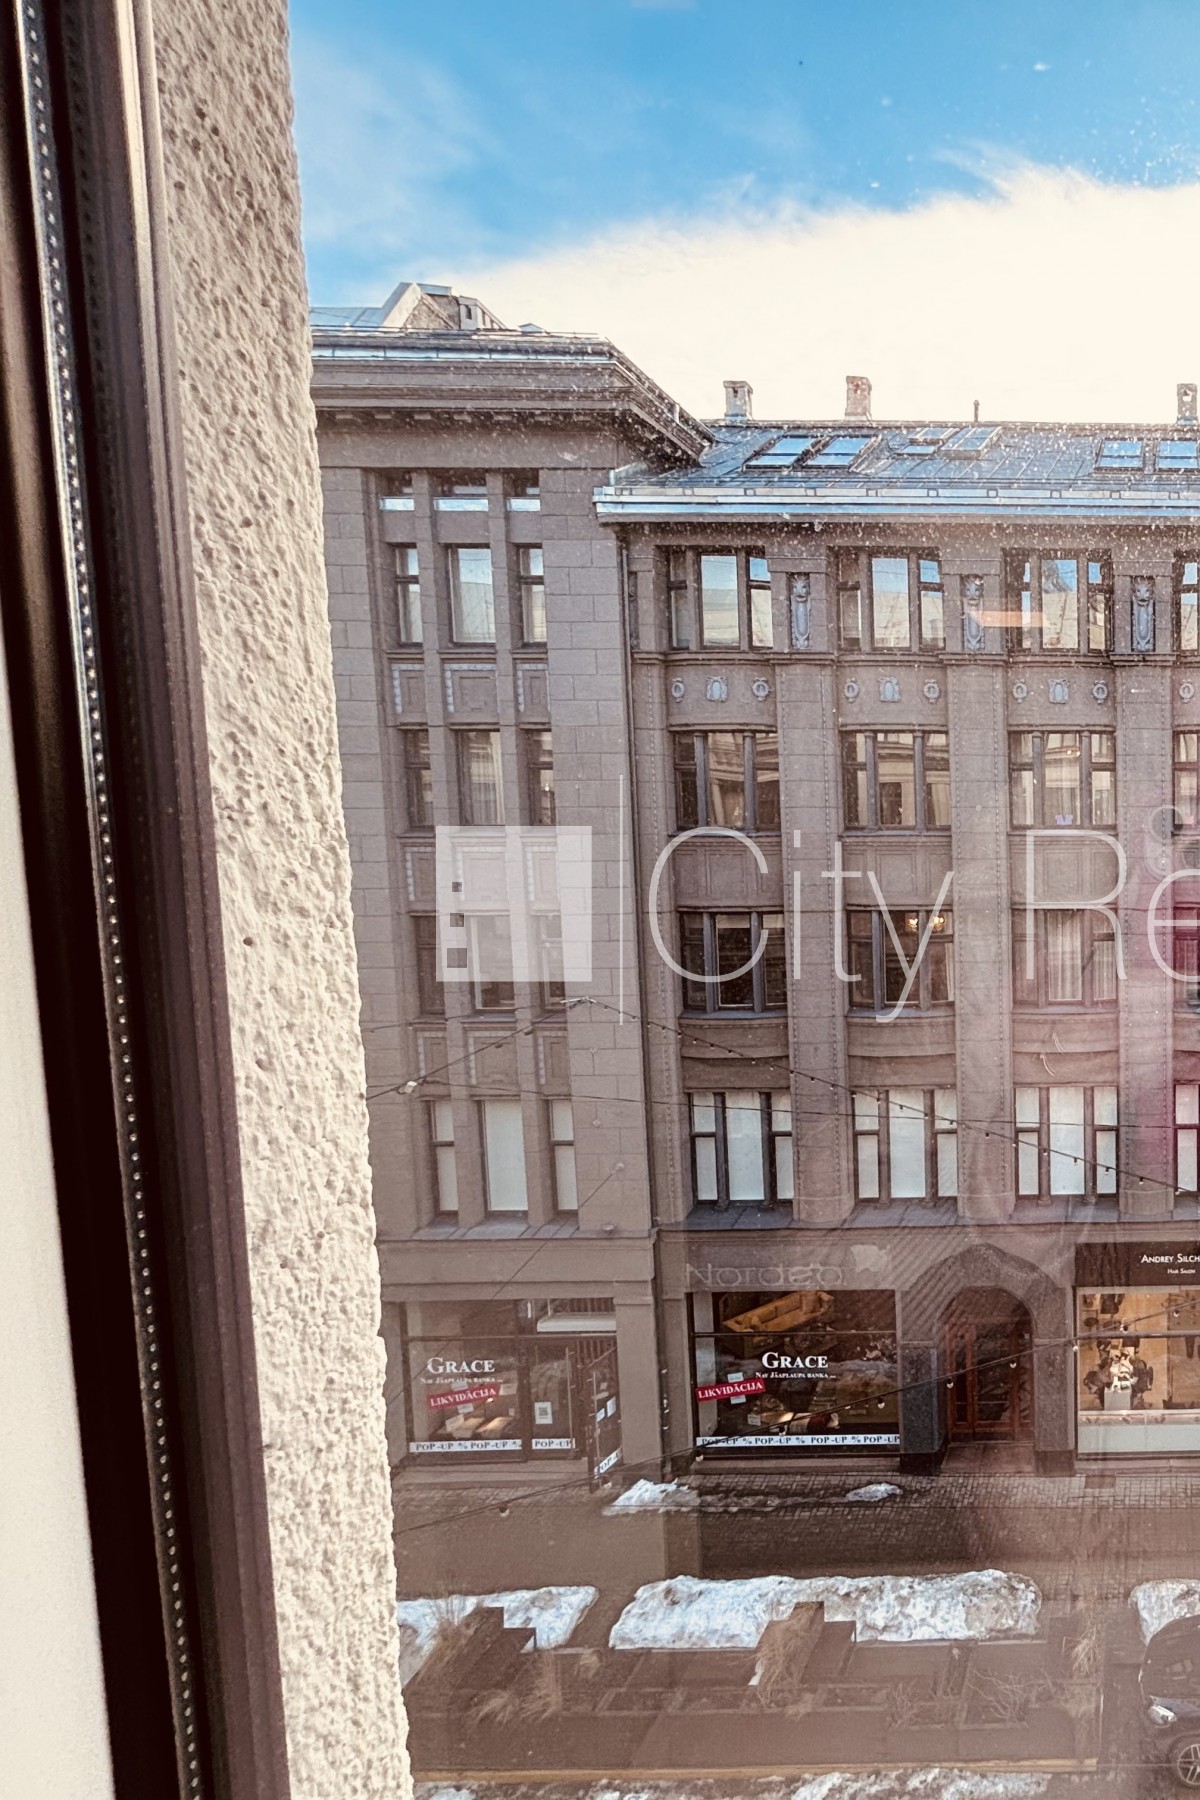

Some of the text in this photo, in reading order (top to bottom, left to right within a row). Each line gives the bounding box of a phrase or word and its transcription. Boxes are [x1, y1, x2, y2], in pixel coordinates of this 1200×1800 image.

[1140, 1254, 1174, 1264] ANDREY
[426, 1356, 496, 1374] GRACE
[761, 1351, 829, 1369] GRACE
[429, 1387, 497, 1407] LIKVIDĀCIJA
[697, 1381, 764, 1399] LIKVIDĀCIJA
